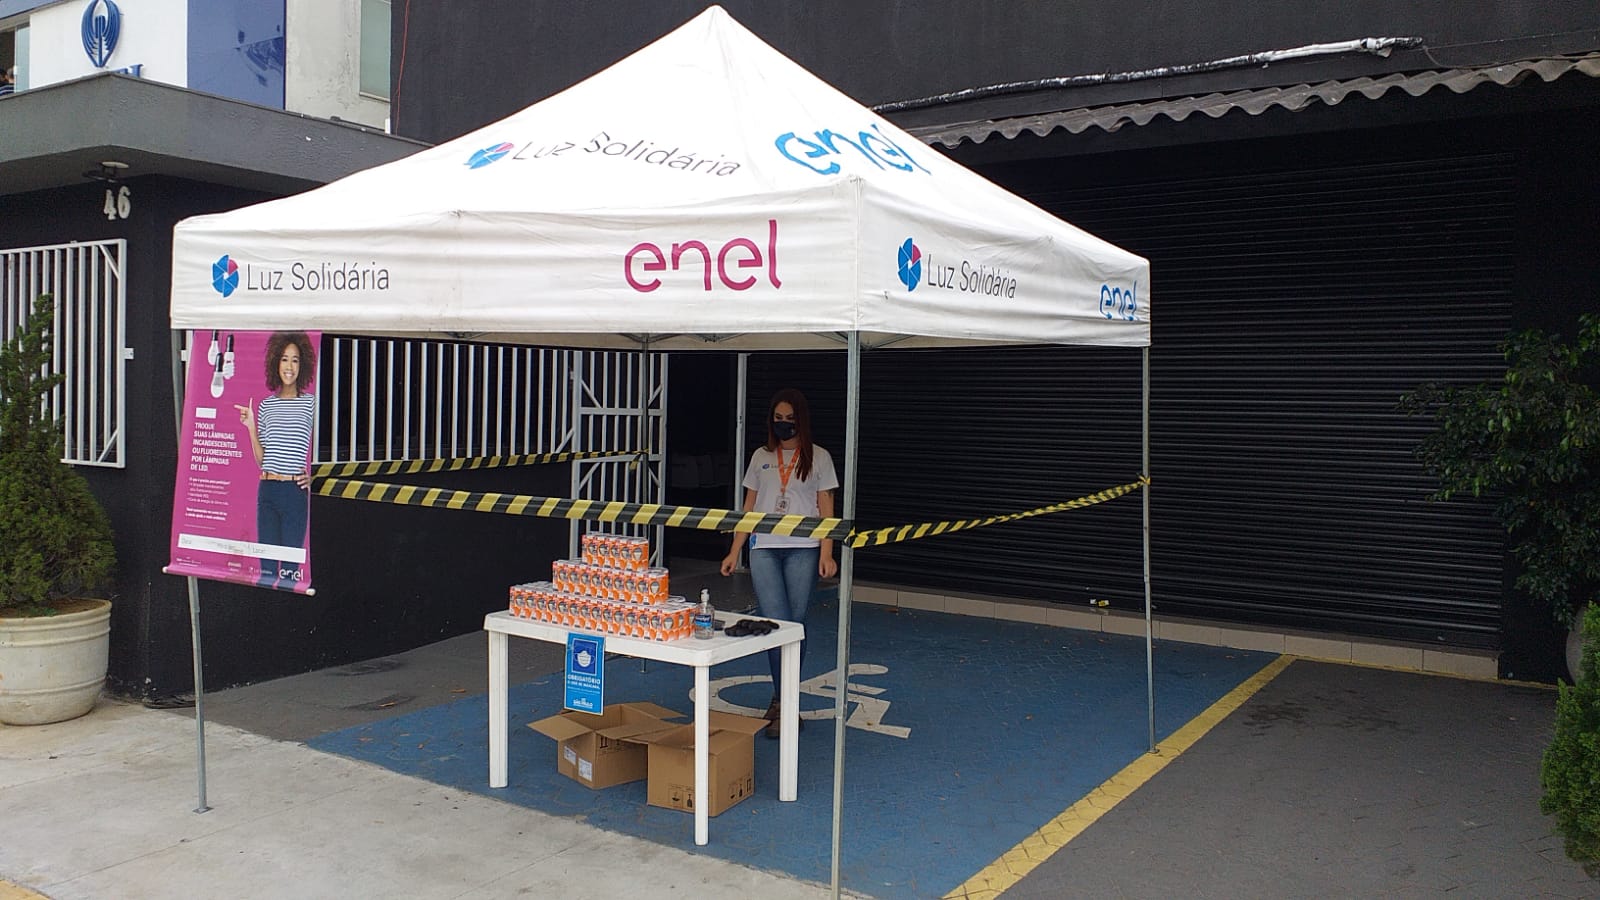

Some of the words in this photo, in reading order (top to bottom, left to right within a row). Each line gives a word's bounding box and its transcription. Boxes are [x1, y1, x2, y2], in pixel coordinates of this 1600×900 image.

[512, 141, 576, 161] Luz
[583, 131, 741, 177] Solidária
[775, 124, 933, 175] enel
[103, 185, 131, 221] 46
[624, 219, 782, 293] enel
[247, 263, 284, 291] Luz
[291, 262, 390, 291] Solidária
[927, 253, 956, 290] Luz
[959, 260, 1018, 299] Solidária
[1099, 280, 1139, 322] enel
[194, 422, 215, 430] TROQUE
[192, 438, 237, 449] INCANDESCENTES
[200, 448, 243, 458] FLUORESCENTES
[190, 463, 198, 471] DE
[191, 455, 203, 463] POR
[279, 568, 304, 581] enel
